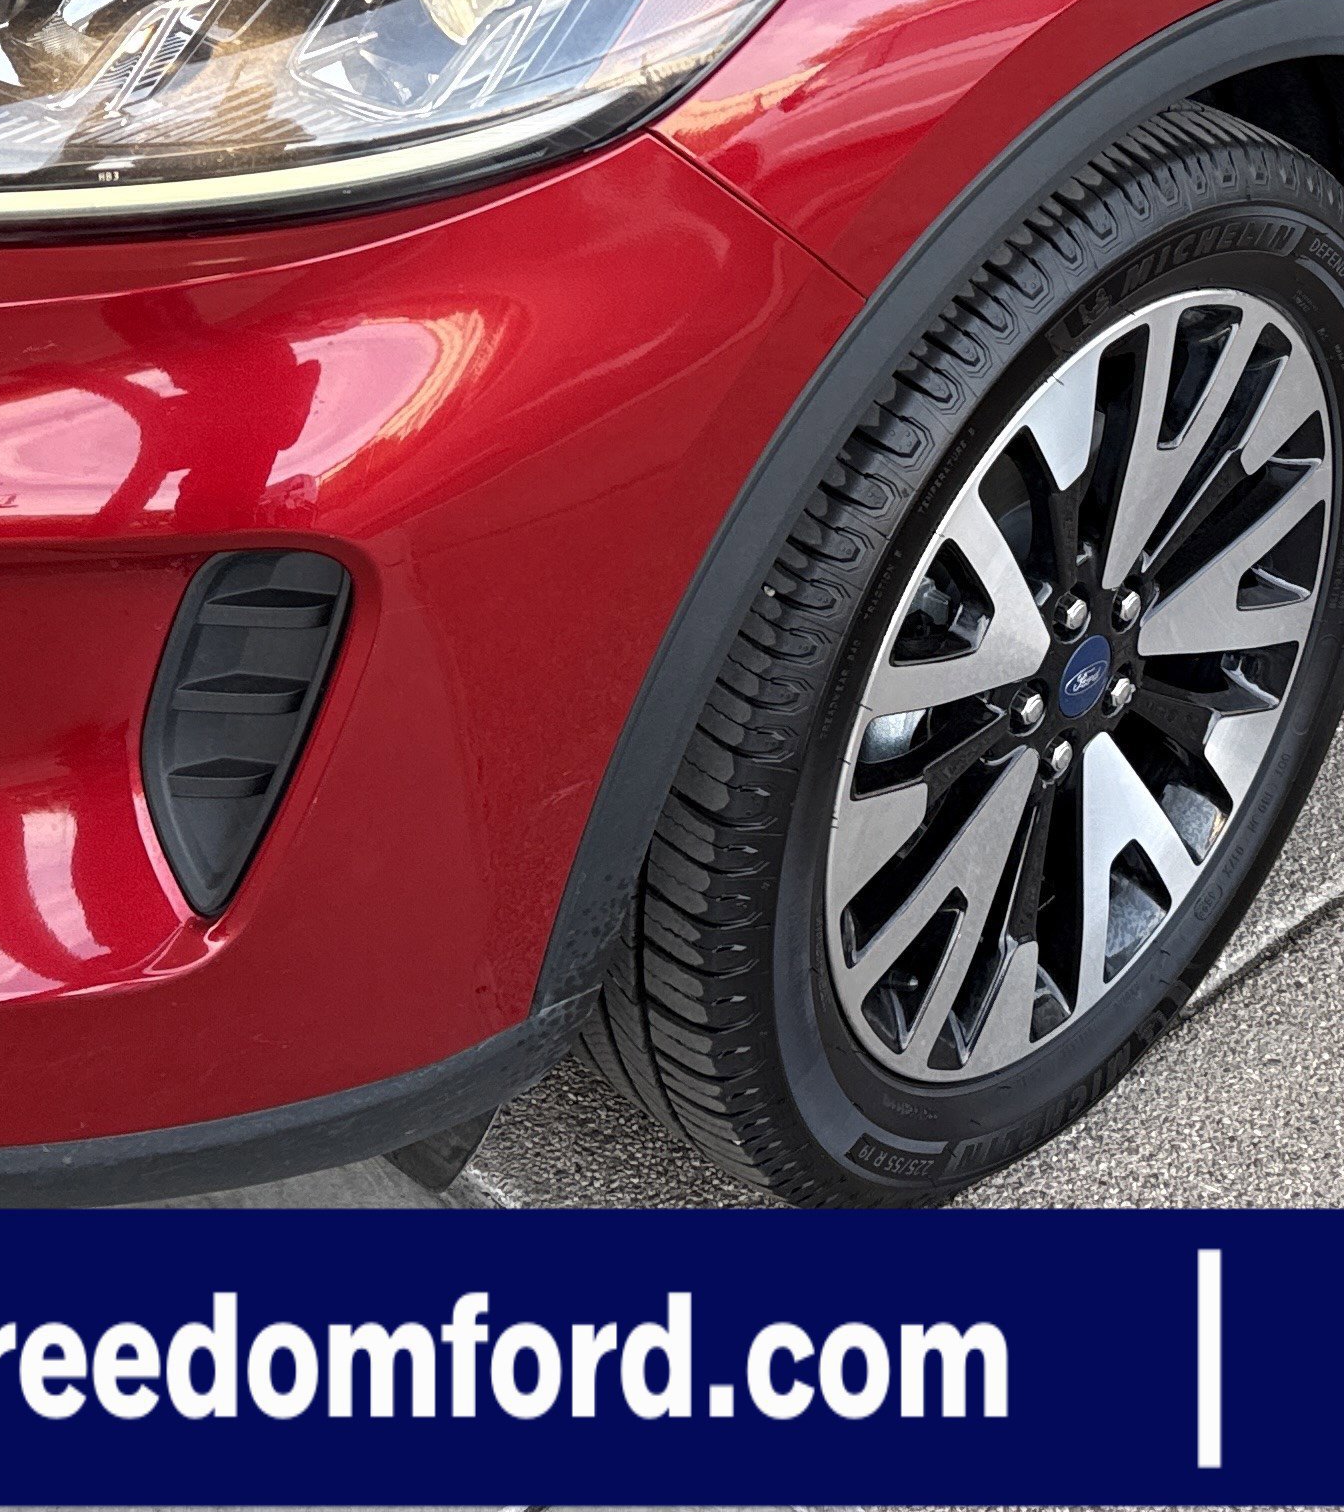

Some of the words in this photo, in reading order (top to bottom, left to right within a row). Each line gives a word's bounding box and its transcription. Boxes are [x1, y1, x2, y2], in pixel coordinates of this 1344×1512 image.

[1120, 220, 1296, 299] MICHELIN
[1072, 667, 1102, 693] Ford
[857, 1143, 875, 1161] 19
[873, 1151, 887, 1168] R
[883, 1155, 935, 1177] 225/55
